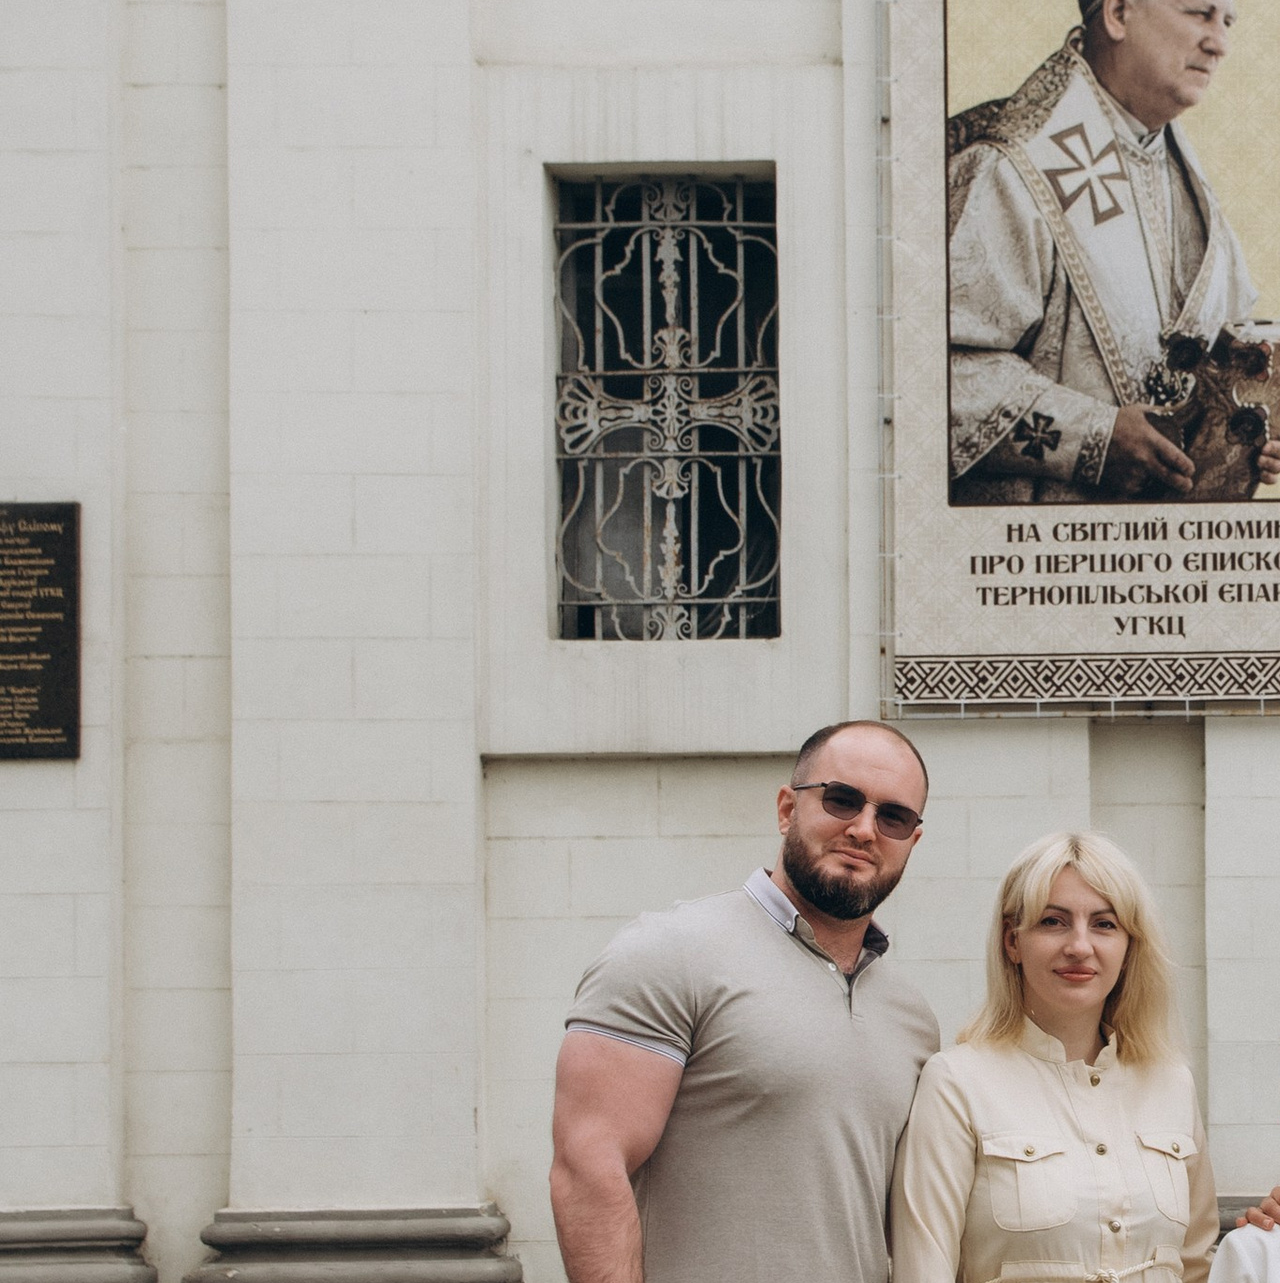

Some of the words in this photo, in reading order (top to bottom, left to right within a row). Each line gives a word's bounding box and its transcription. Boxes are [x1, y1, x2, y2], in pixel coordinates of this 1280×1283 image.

[1006, 522, 1042, 544] НА
[1052, 517, 1168, 543] СВІТЛИЙ
[970, 554, 1025, 576] ПРО
[1035, 552, 1173, 575] ПЕРШОГО
[976, 580, 1208, 607] ТЕРНОПІЛЬСЬКОЇ
[1113, 615, 1187, 638] УГКЦ
